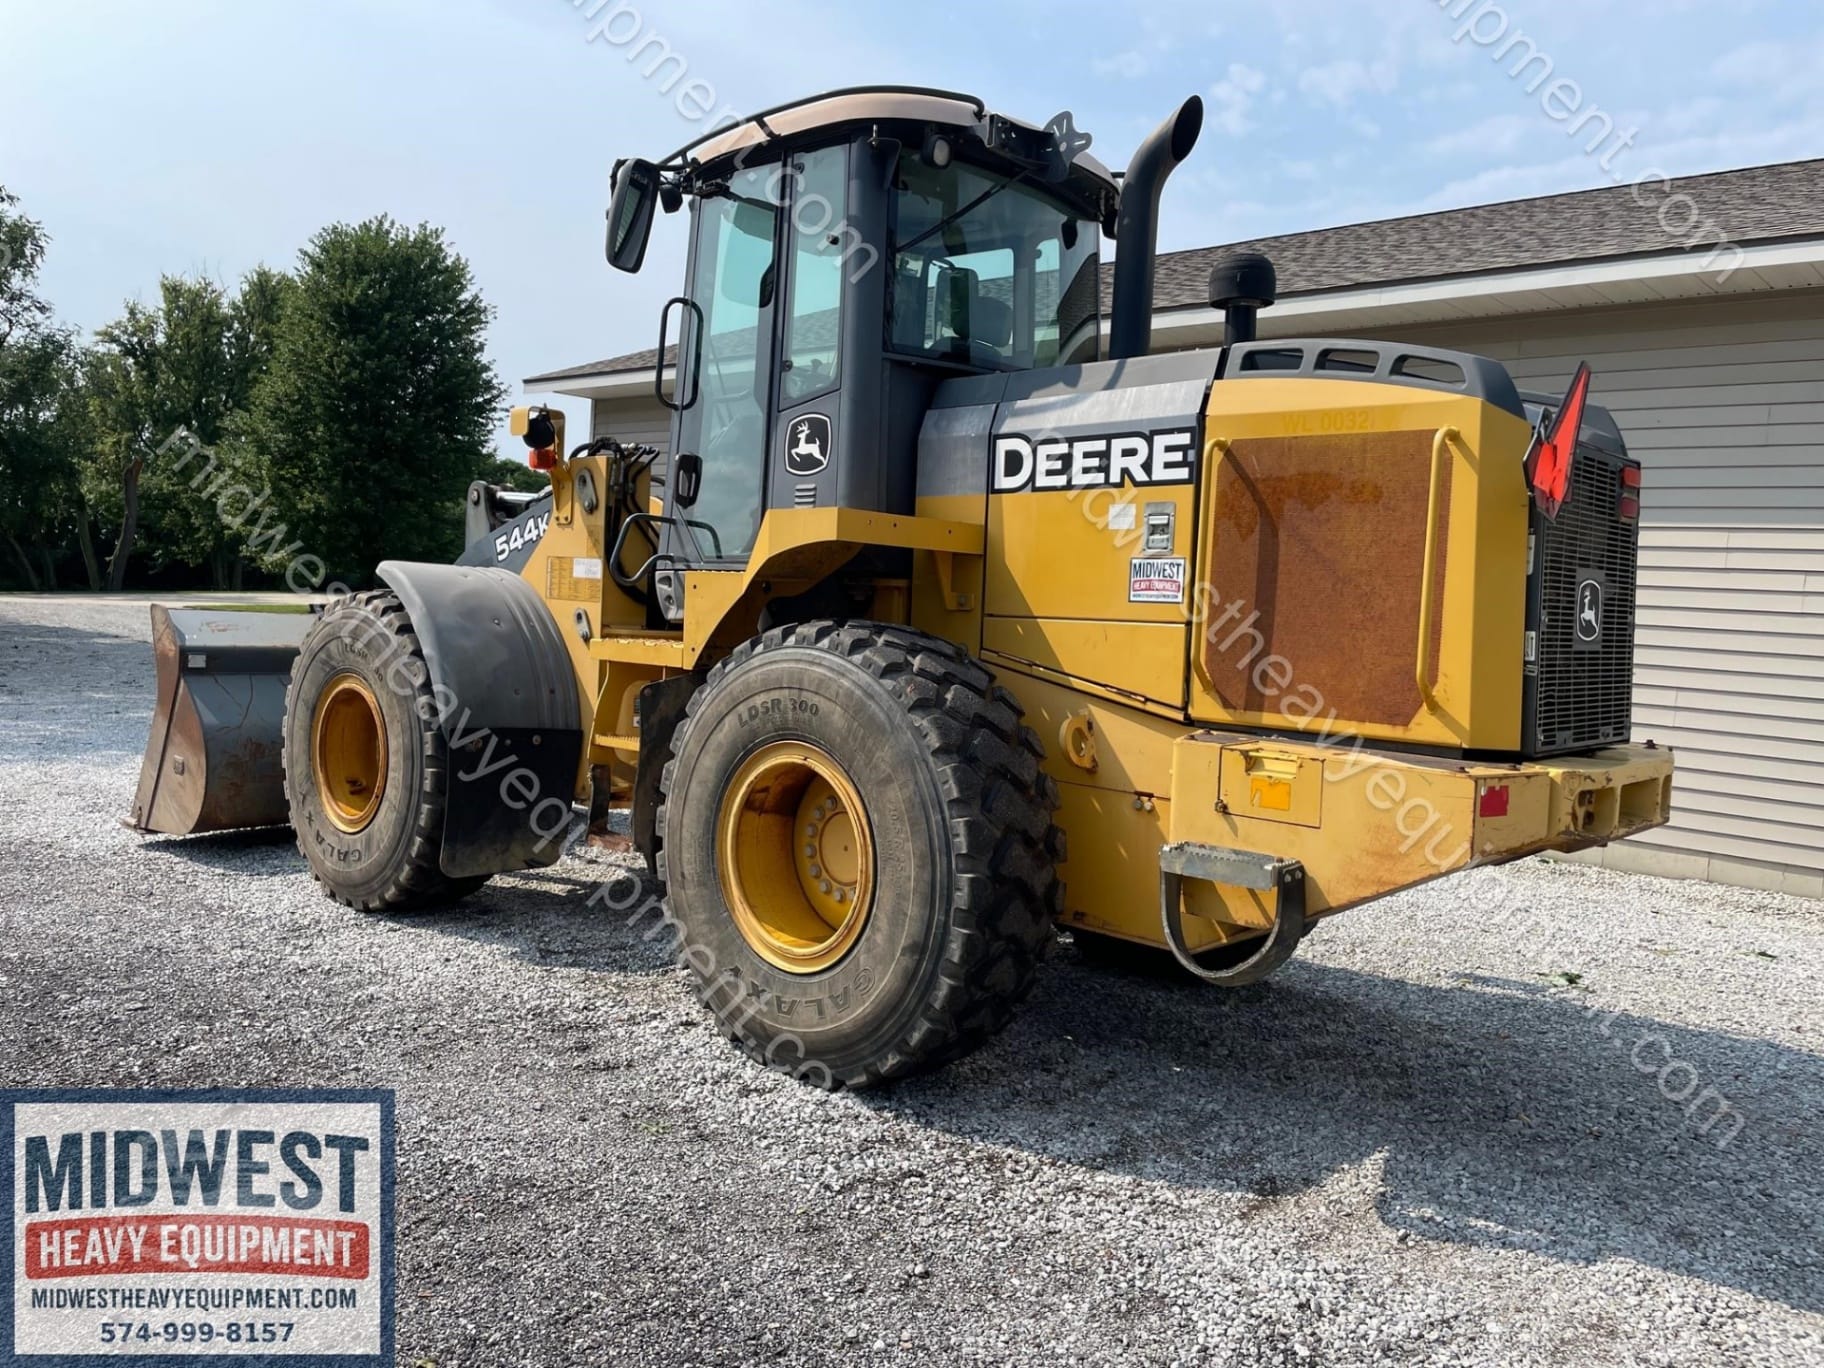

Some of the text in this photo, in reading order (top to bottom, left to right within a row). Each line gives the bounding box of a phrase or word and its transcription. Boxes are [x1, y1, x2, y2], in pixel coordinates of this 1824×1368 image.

[993, 431, 1193, 490] DEERE
[495, 511, 550, 562] 544K
[1132, 561, 1182, 579] MIDWEST
